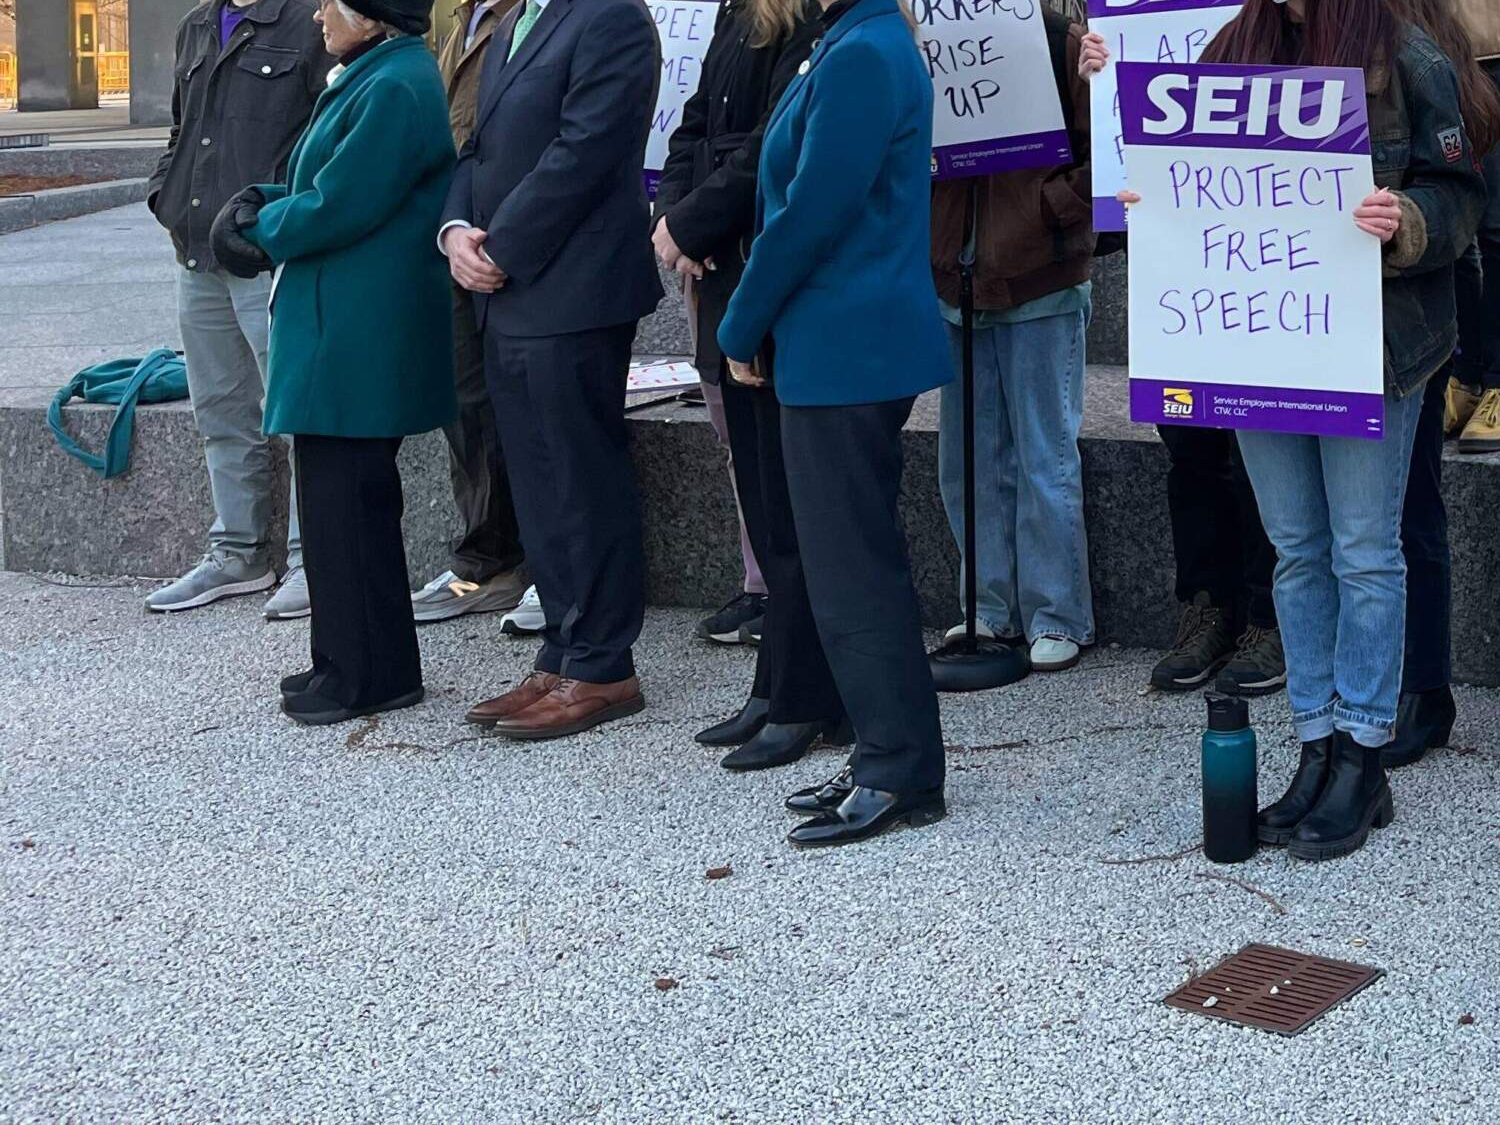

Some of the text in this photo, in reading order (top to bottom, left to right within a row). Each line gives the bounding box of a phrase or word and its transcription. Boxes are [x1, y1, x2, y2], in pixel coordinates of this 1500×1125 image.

[922, 35, 1004, 78] RISE
[944, 79, 1001, 119] UP
[1142, 73, 1345, 140] SEIU
[1169, 161, 1353, 212] PROTECT
[1203, 224, 1319, 272] FREE
[1159, 289, 1329, 336] SPEECH
[1163, 404, 1192, 414] SEIU
[1213, 396, 1348, 413] Service Employees International Union
[1233, 407, 1248, 416] CLC
